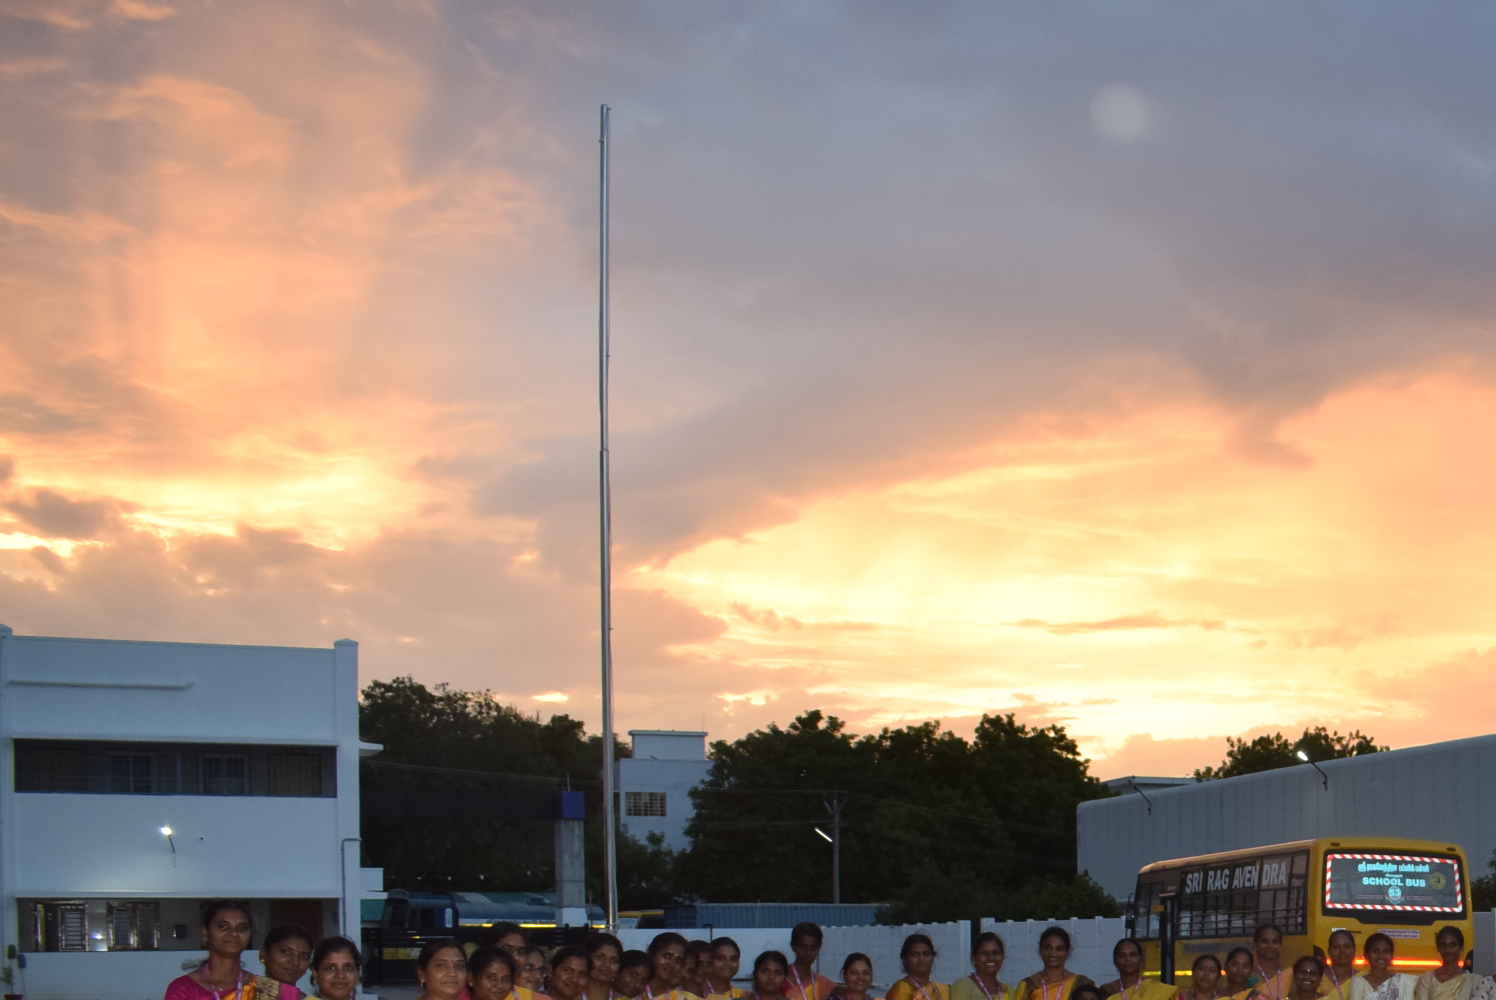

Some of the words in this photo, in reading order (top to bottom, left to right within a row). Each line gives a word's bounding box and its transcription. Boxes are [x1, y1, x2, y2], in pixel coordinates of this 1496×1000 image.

[1185, 870, 1203, 894] SRI
[1362, 877, 1404, 886] SCHOOL
[1405, 878, 1426, 887] BUS
[1389, 888, 1400, 897] 53
